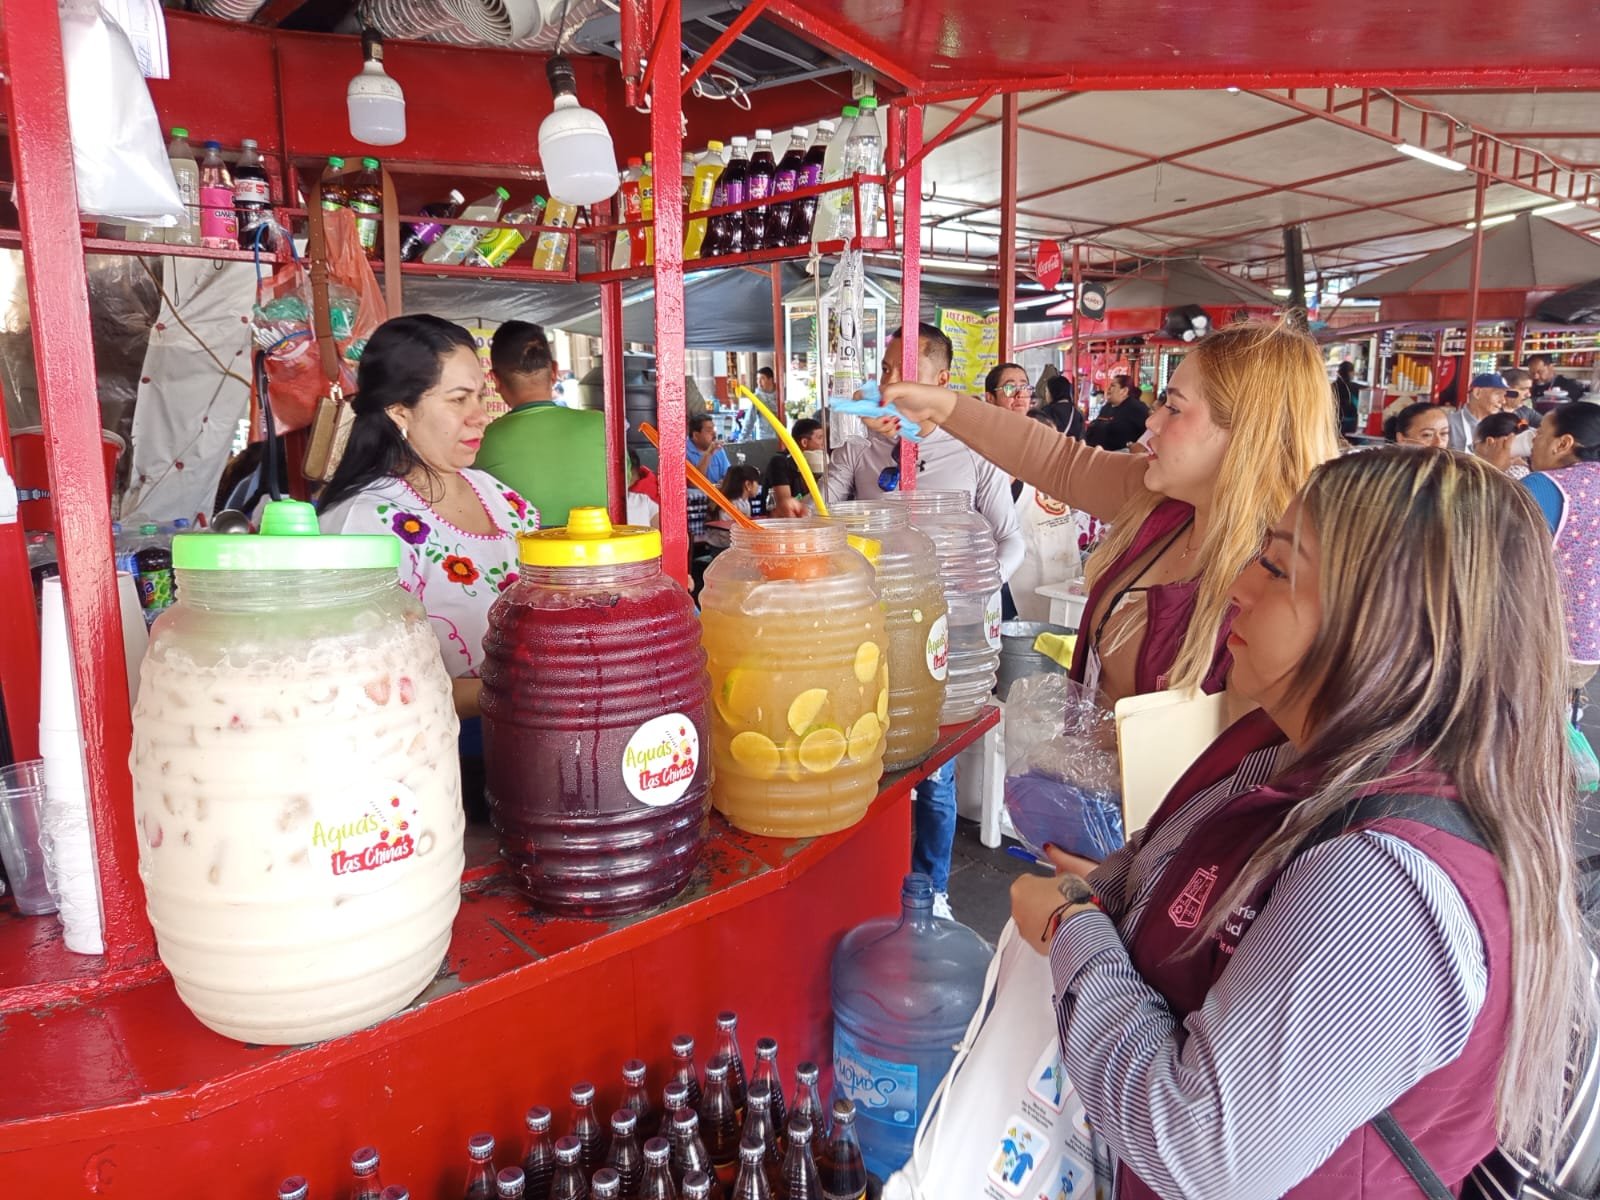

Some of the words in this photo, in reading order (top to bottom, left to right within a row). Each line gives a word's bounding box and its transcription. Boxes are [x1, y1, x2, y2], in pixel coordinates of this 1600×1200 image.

[625, 740, 672, 770] Aguas
[643, 771, 660, 789] Las
[662, 764, 692, 784] Chinas
[312, 814, 378, 850] Aguas
[335, 853, 361, 875] Las
[364, 841, 409, 867] Chinas
